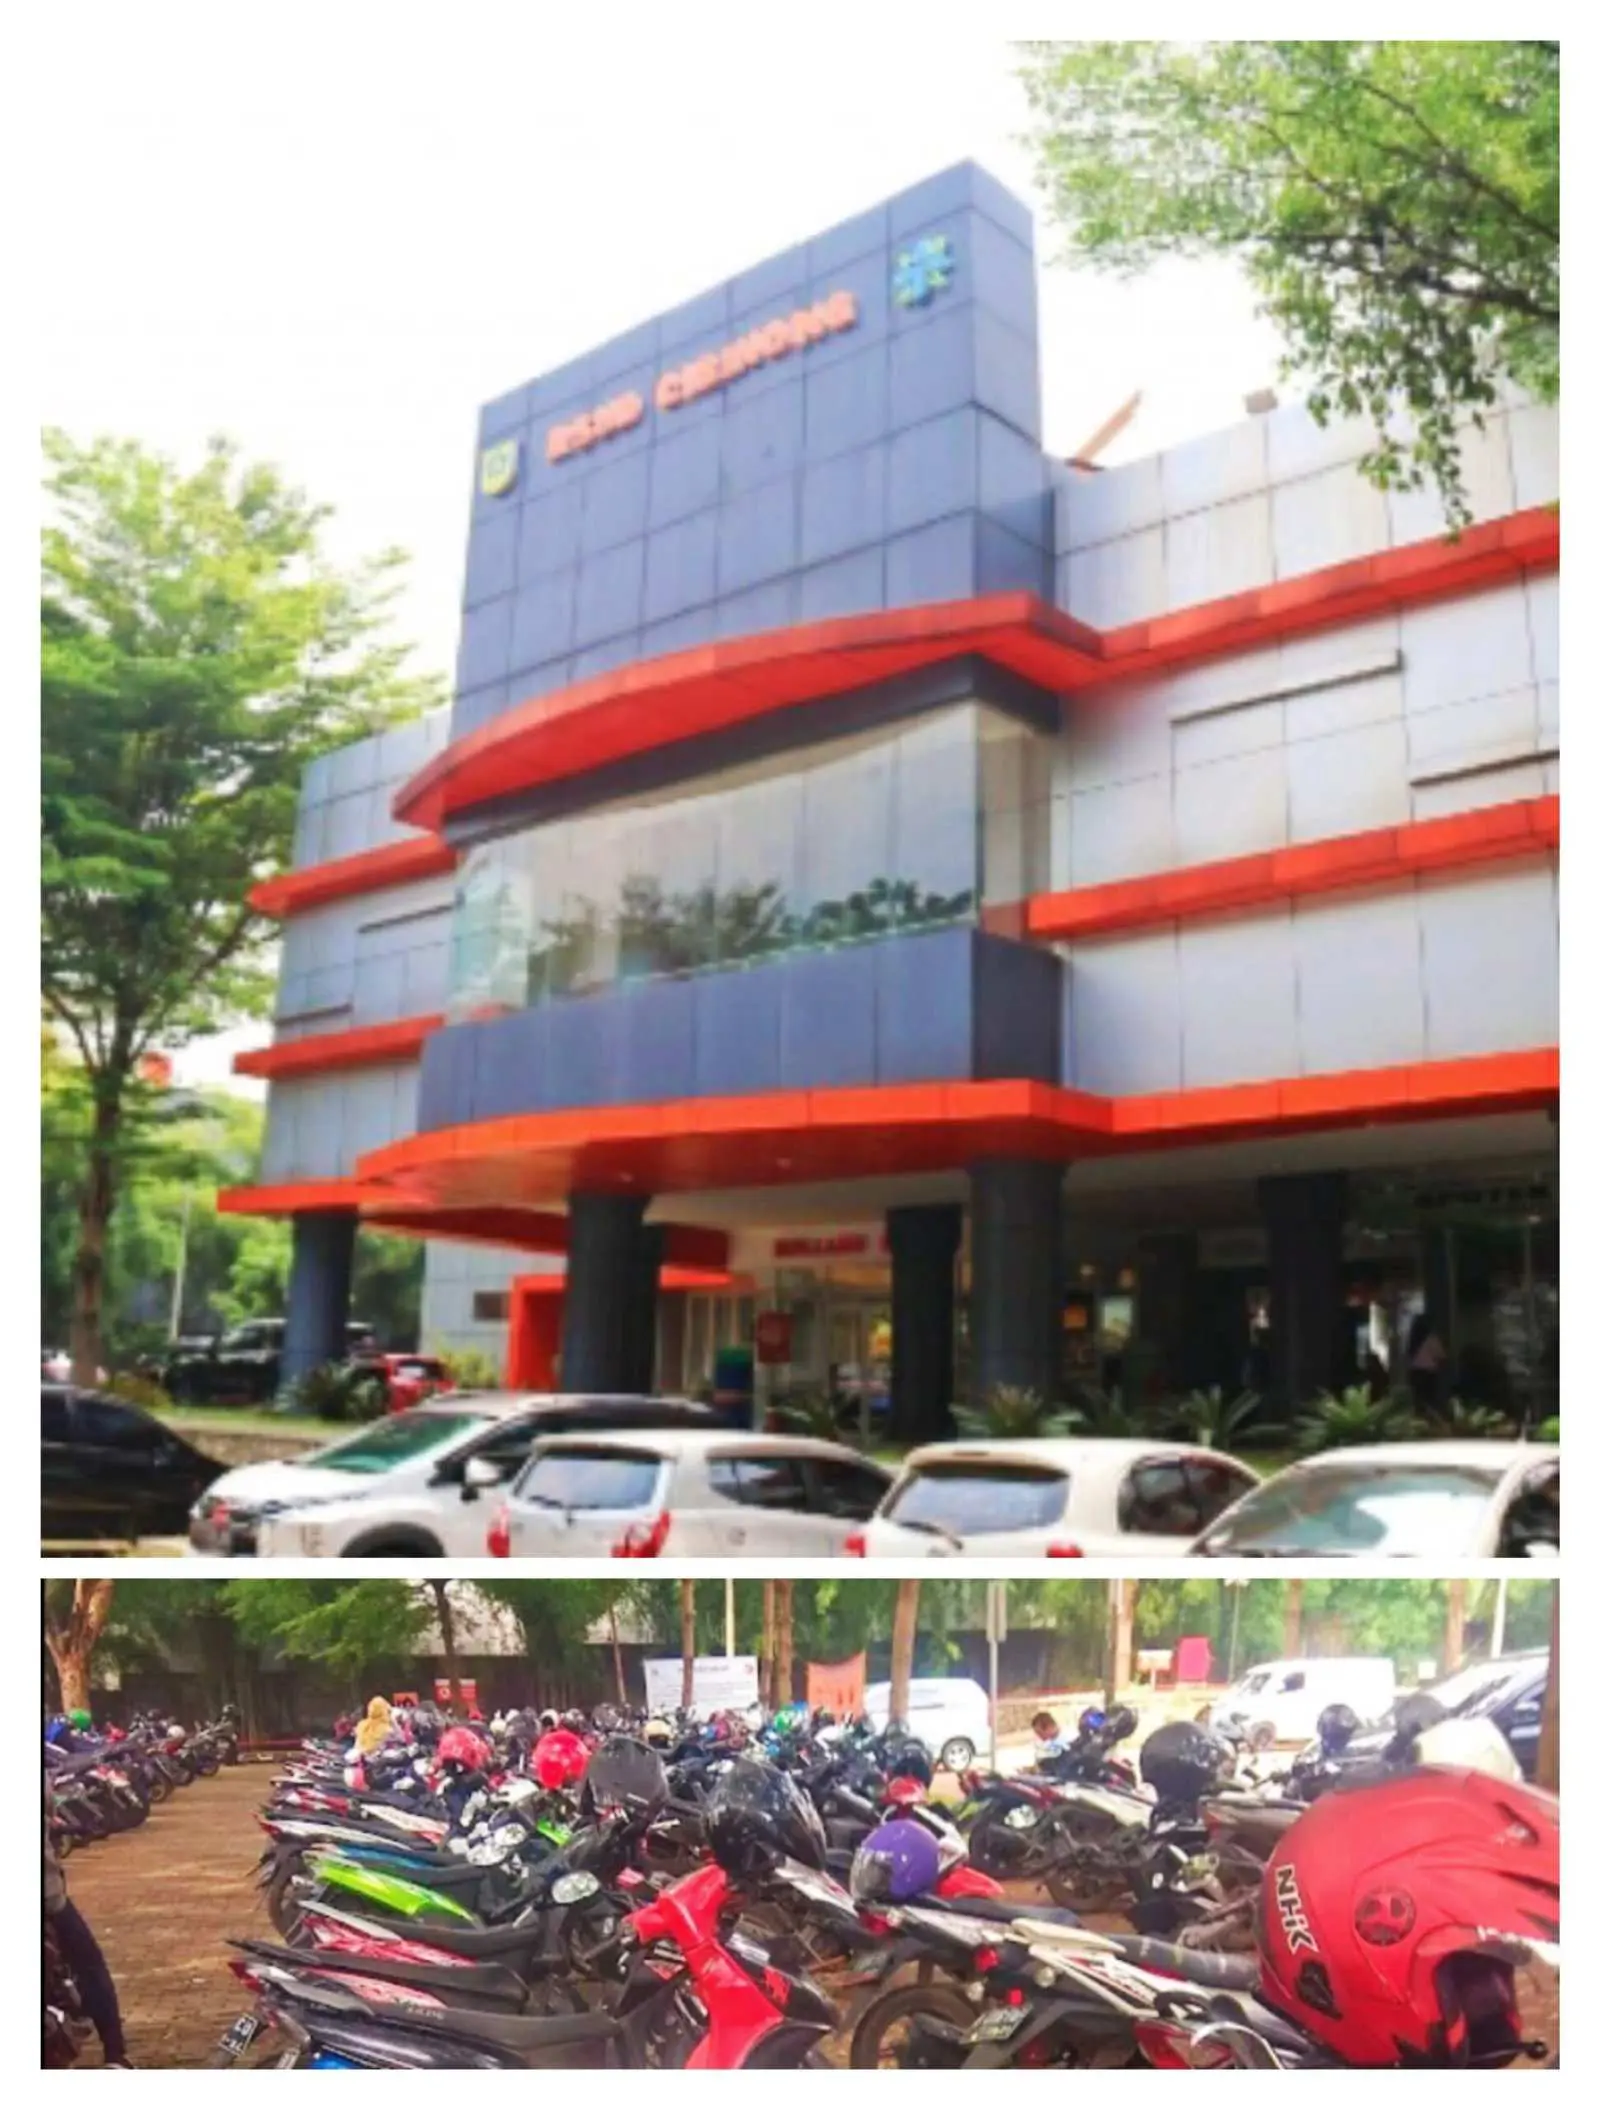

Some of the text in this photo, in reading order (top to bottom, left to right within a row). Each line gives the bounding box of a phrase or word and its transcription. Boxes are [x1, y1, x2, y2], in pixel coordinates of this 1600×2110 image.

[546, 289, 857, 465] RSUD CIBINONG
[1274, 1862, 1320, 1955] NHK
